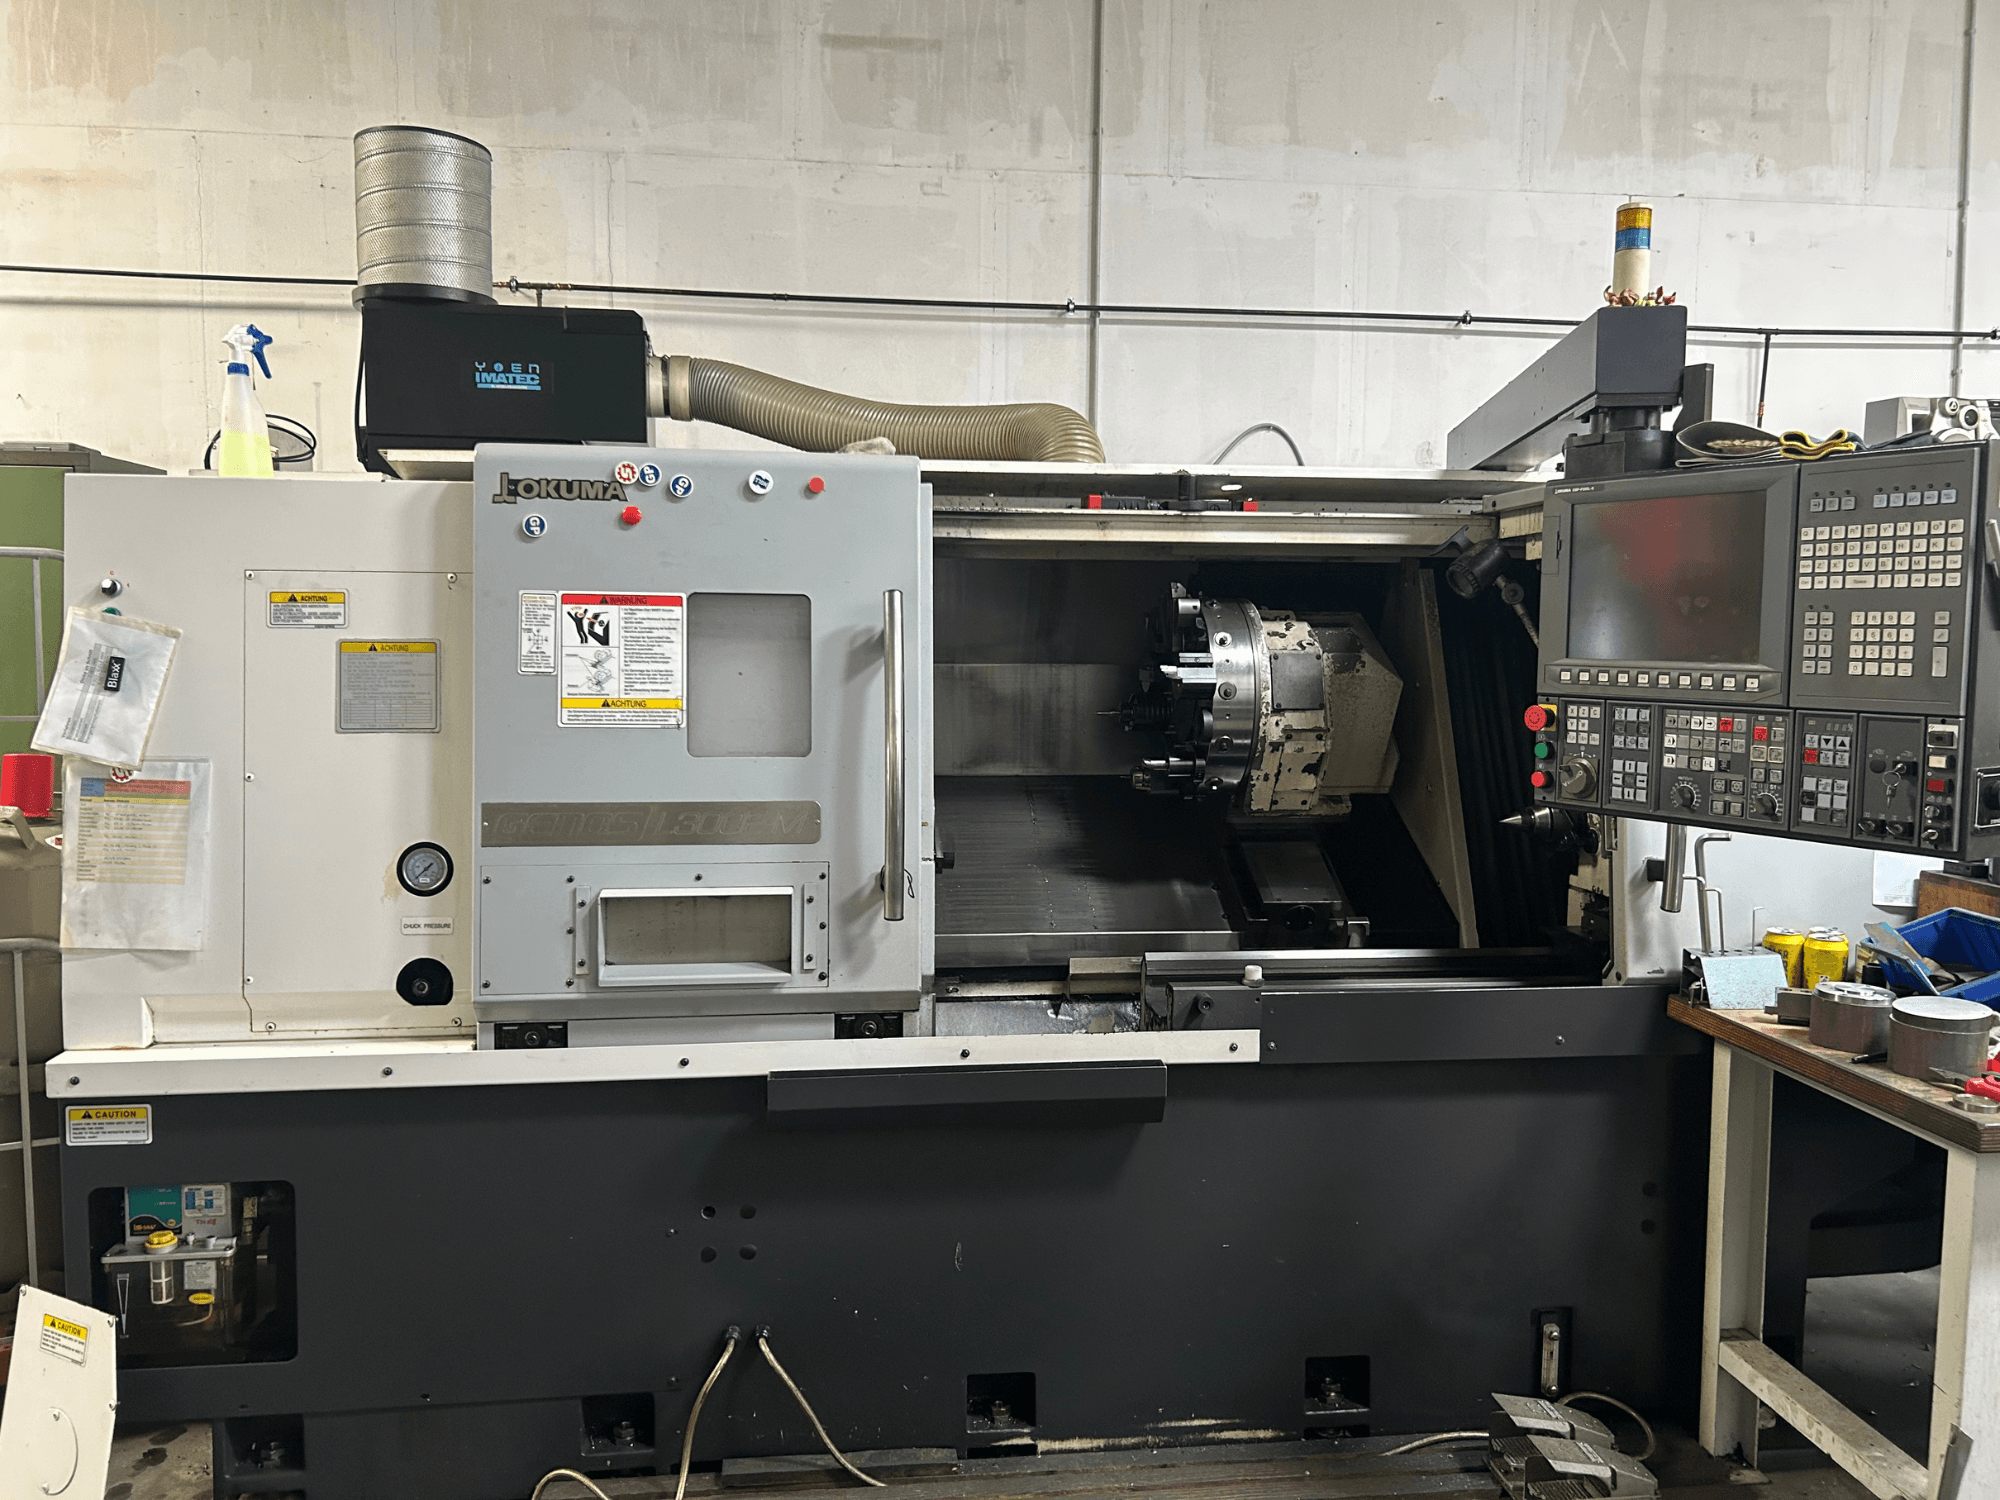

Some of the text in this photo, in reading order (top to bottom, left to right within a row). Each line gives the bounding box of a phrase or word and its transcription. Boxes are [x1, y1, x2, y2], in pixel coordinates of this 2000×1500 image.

[475, 372, 540, 384] IMATEC
[644, 466, 656, 484] GP
[517, 478, 627, 500] OKUMA
[676, 478, 689, 496] GP
[530, 516, 540, 536] GP
[107, 662, 120, 688] Blaxx
[95, 1110, 136, 1118] CAUTION
[57, 1322, 81, 1336] CAUTION
